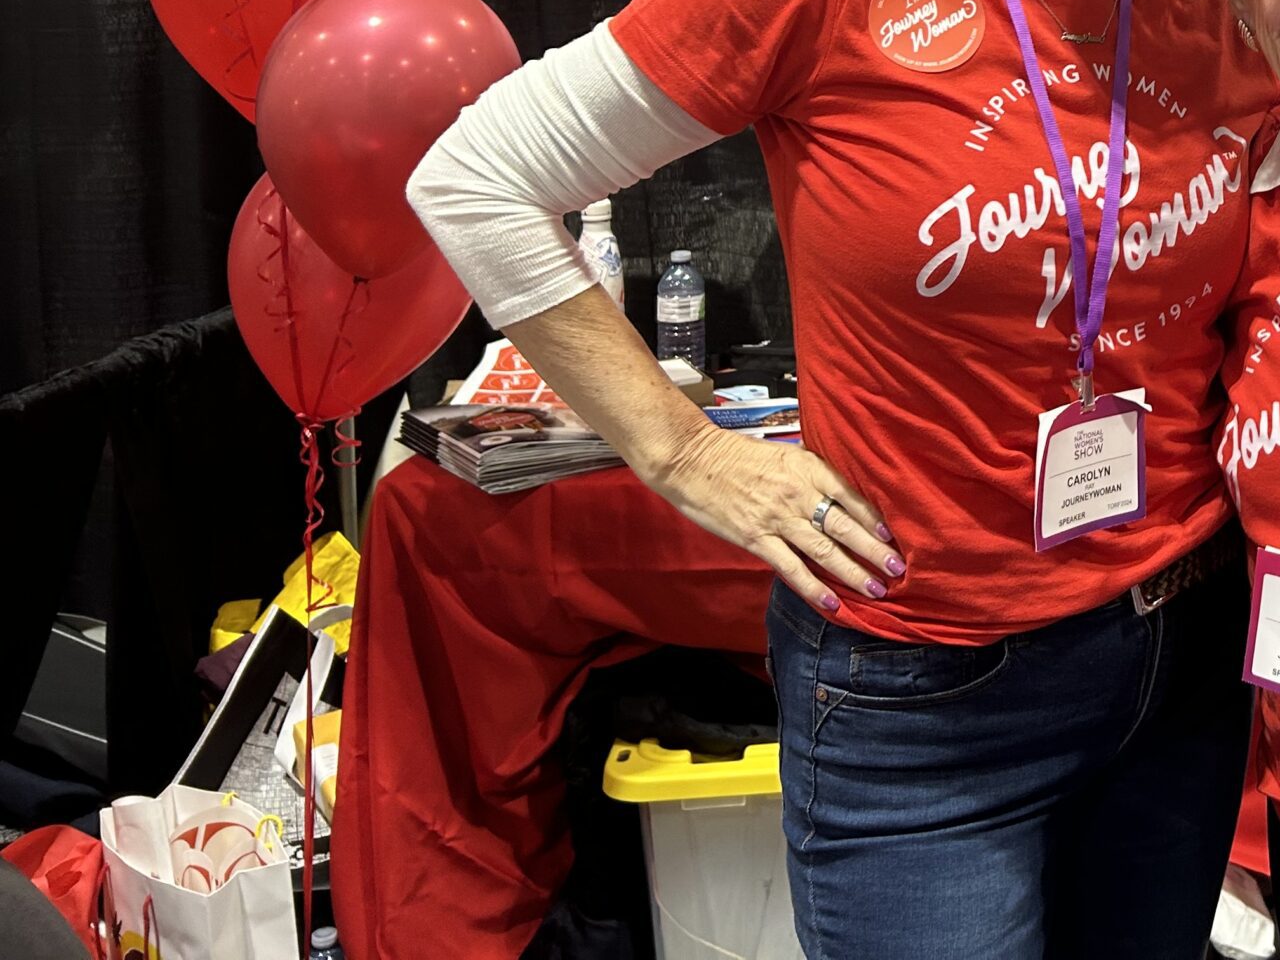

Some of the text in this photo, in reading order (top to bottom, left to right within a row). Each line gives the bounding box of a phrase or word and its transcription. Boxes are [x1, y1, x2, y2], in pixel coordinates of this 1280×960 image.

[880, 0, 938, 48] Journey
[911, 0, 977, 53] Woman
[964, 62, 1187, 152] INSPIRNG WMEN
[1068, 321, 1147, 352] SNCE
[1074, 429, 1103, 442] NATIONAL
[1074, 436, 1104, 449] WOMEN'S
[1074, 443, 1104, 461] SHOW
[1067, 466, 1111, 488] CAROLYN
[1061, 483, 1122, 509] JOURNEYWOMAN
[1058, 511, 1086, 527] SPEAKER
